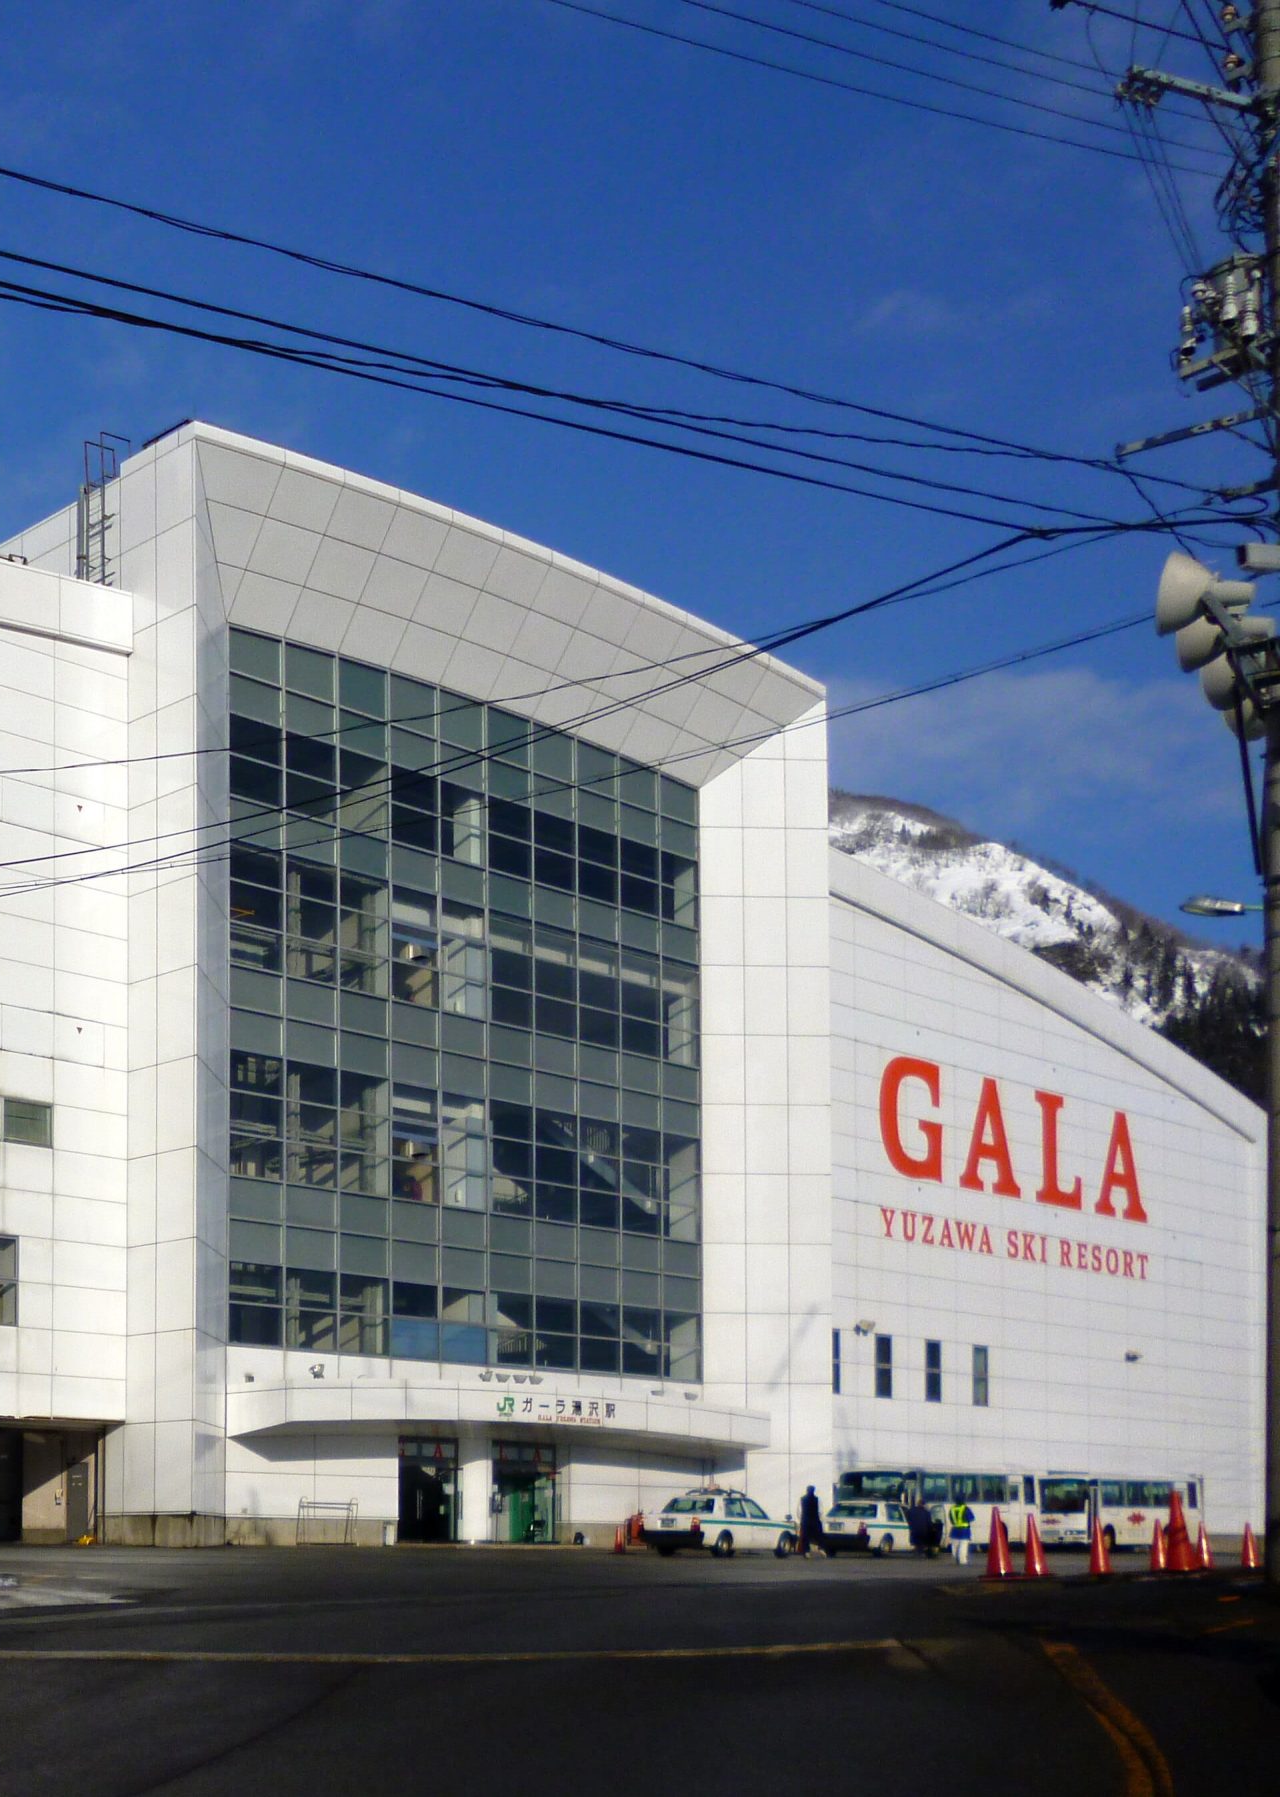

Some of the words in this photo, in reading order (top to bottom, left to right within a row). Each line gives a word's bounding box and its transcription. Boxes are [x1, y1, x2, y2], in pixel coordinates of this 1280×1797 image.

[879, 1055, 1149, 1223] GALA
[880, 1207, 994, 1255] YUZAWA
[1006, 1230, 1049, 1264] SKI
[1059, 1239, 1150, 1280] RESORT
[496, 1396, 515, 1413] JR
[522, 1397, 616, 1419] ガーラ湯沢駅
